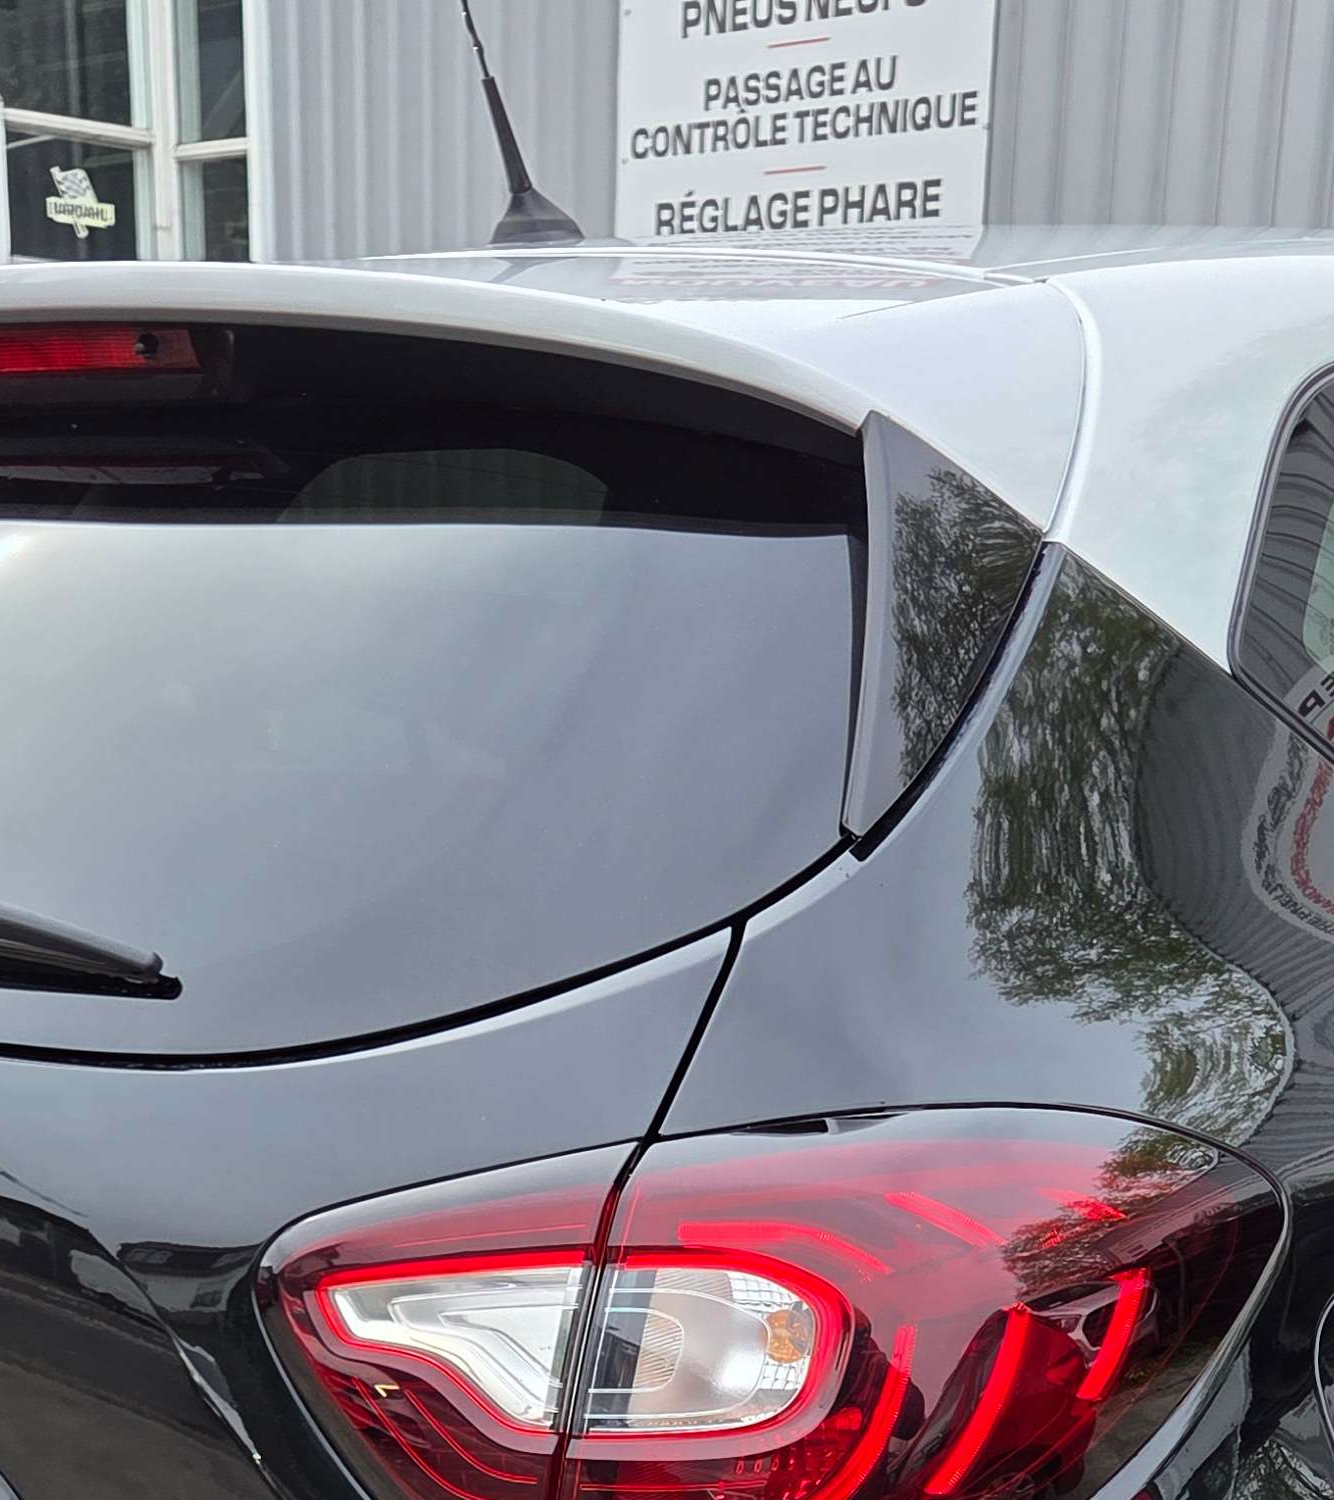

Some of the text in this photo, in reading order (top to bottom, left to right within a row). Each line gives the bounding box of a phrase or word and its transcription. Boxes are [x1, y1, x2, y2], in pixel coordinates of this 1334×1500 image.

[681, 0, 797, 38] PNEUS
[704, 54, 898, 111] PASSAGE AU
[631, 90, 979, 159] CONTRÔLE TECHNIQUE
[655, 178, 943, 236] RÉGLAGE PHARE
